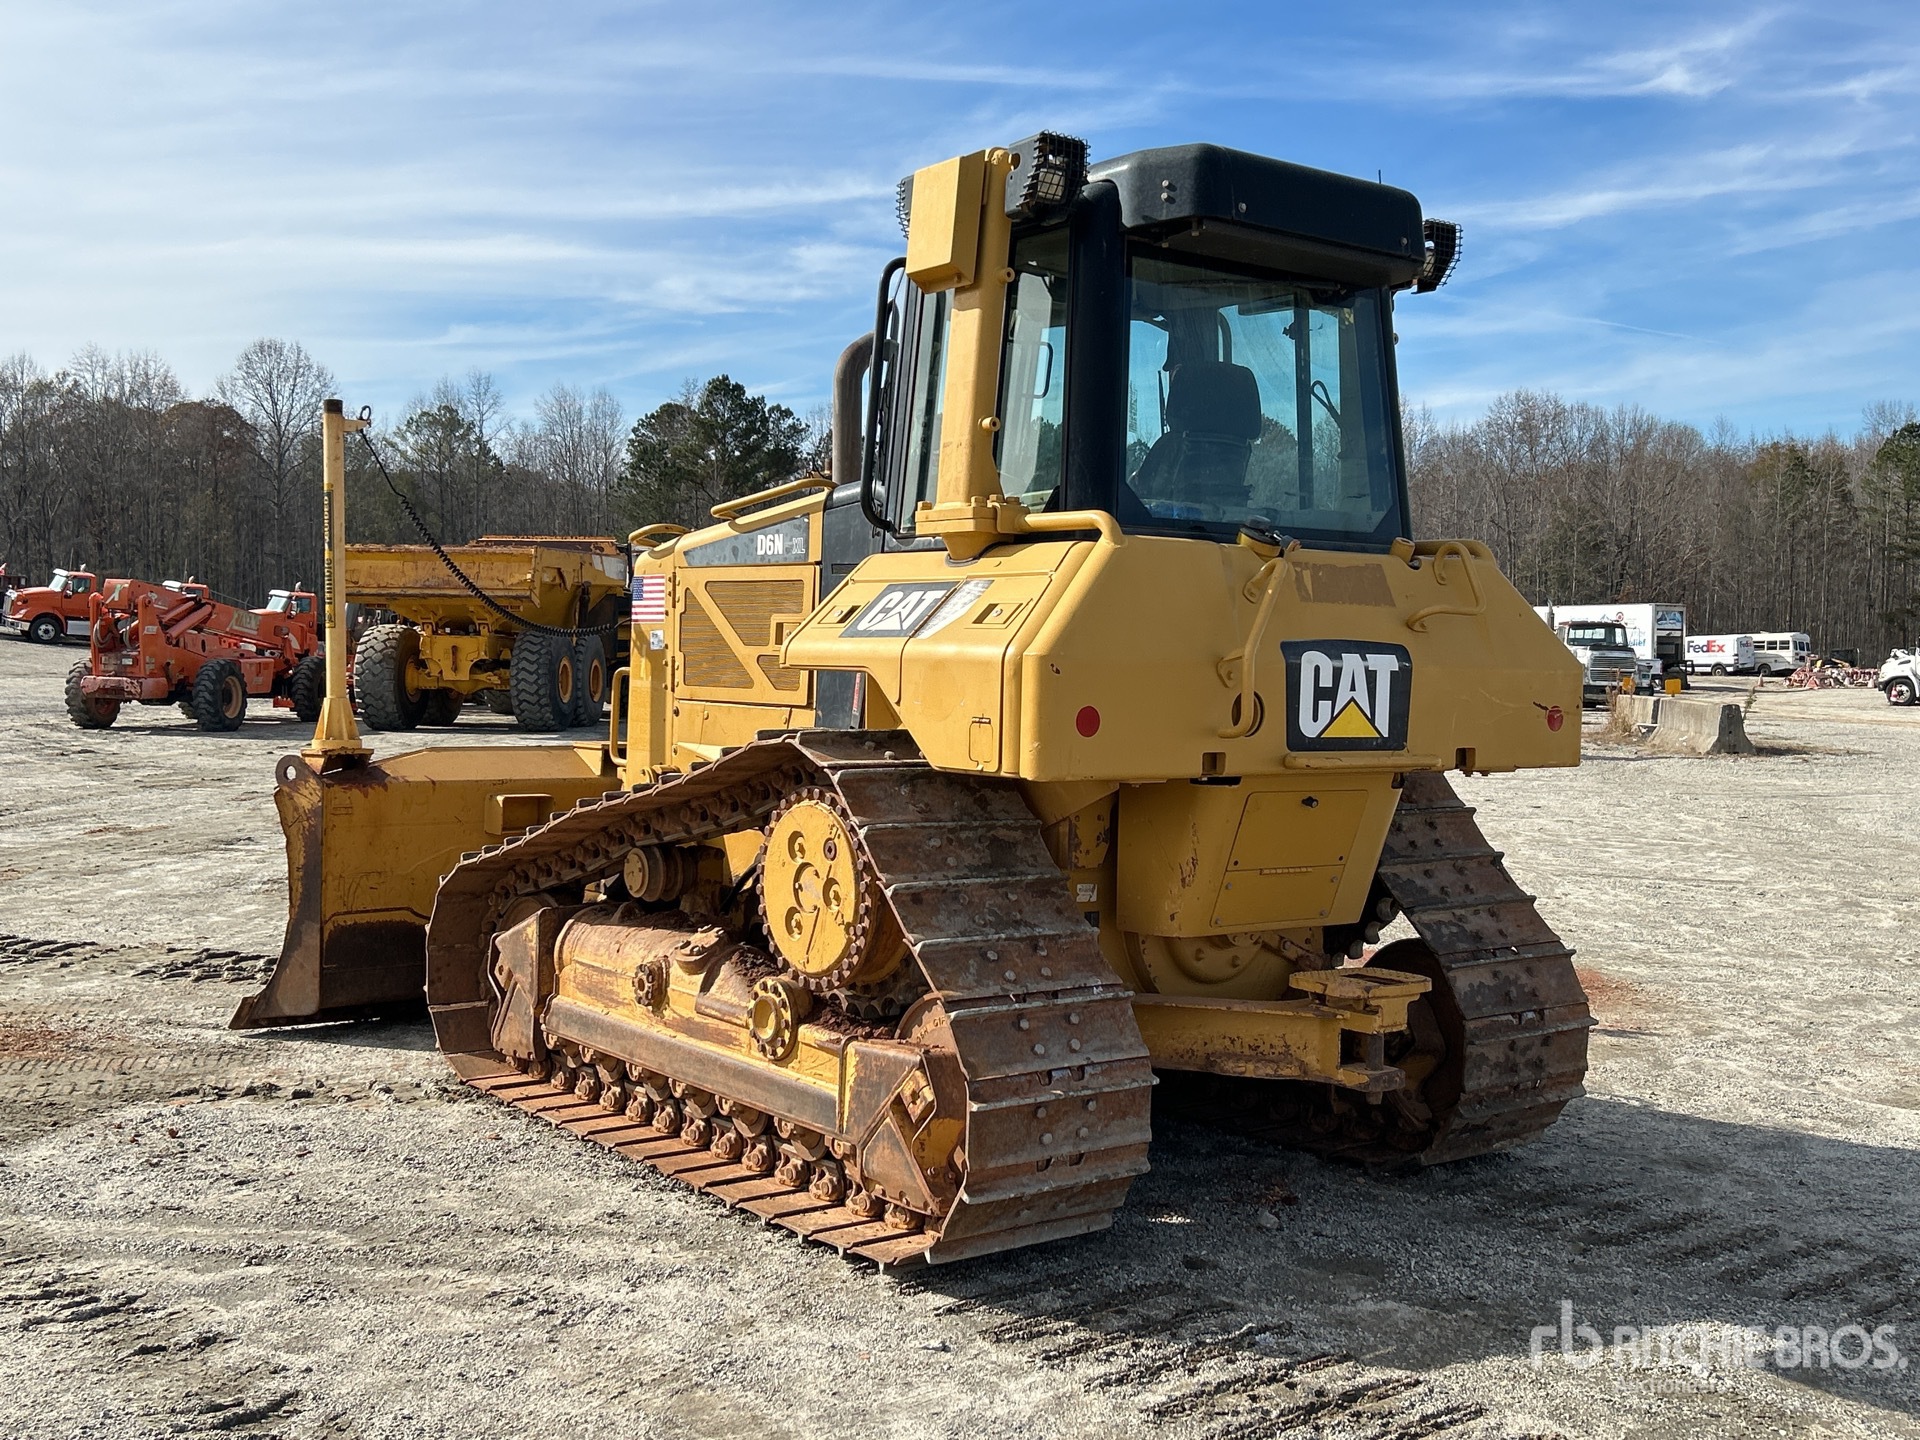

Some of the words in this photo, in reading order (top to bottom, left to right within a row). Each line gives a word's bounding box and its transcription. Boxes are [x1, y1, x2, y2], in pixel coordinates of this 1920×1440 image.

[757, 533, 784, 556] D6N
[792, 537, 806, 554] XL
[856, 589, 949, 631] CAT
[1686, 639, 1726, 653] FedEx
[1298, 650, 1399, 738] CAT
